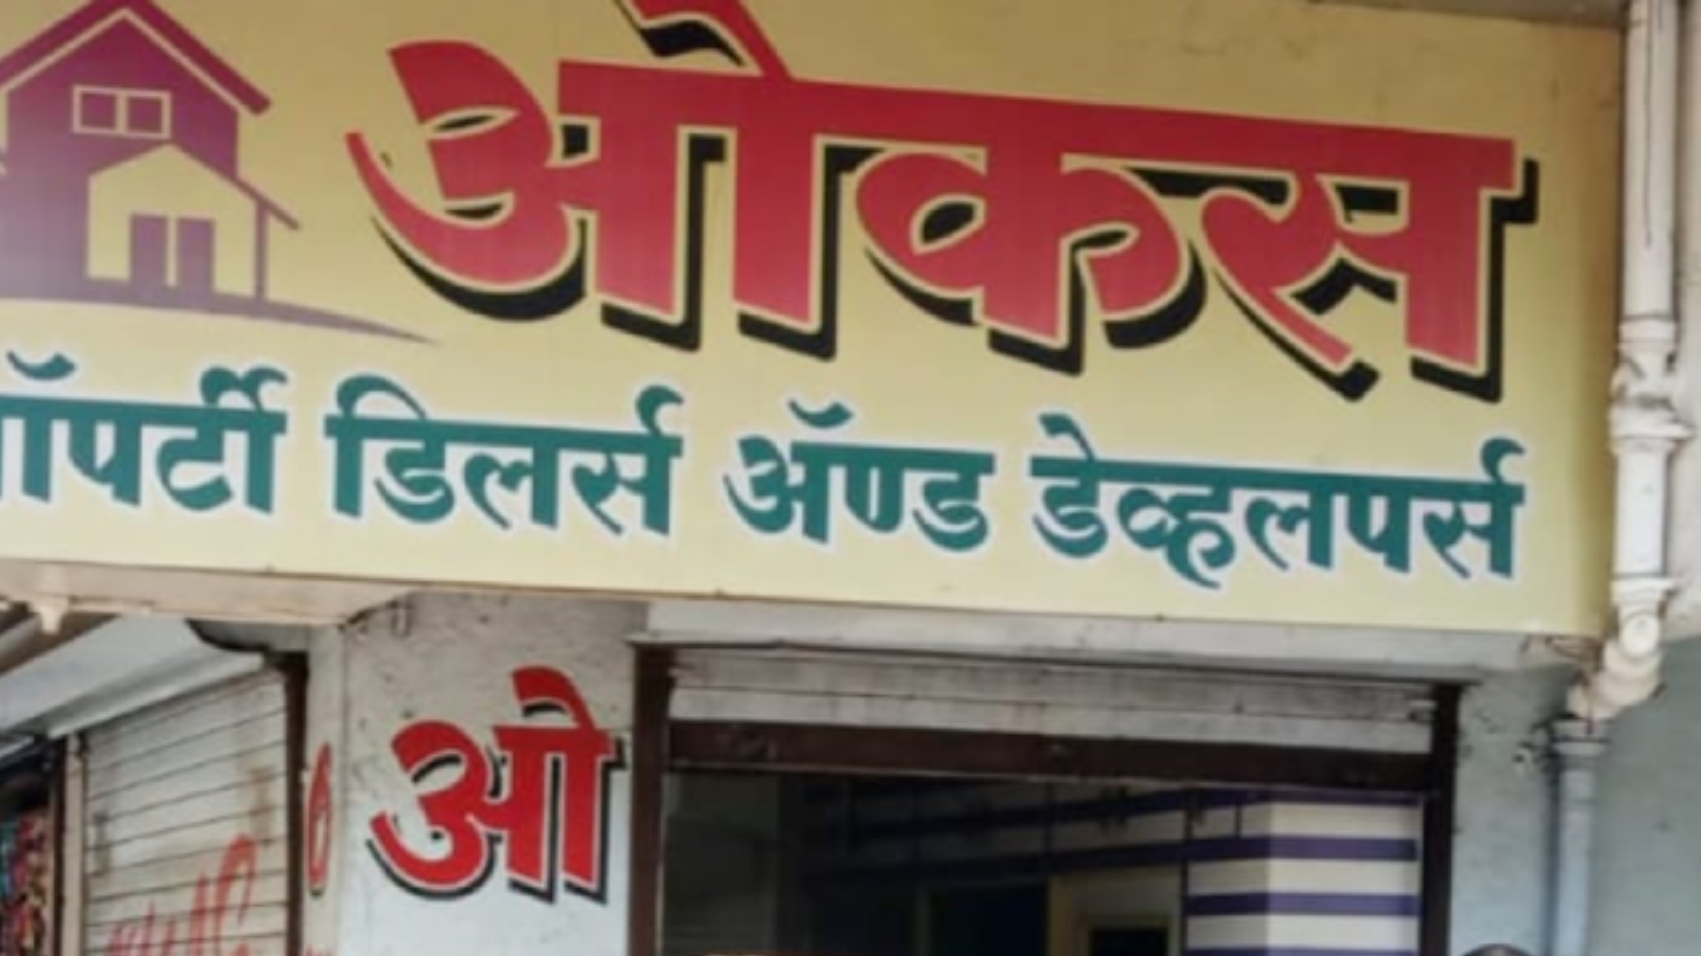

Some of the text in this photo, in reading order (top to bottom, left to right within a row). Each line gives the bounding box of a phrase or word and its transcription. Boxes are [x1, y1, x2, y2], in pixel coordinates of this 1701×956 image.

[345, 0, 1537, 402] ओकस
[325, 374, 684, 537] डिलर्स
[1029, 412, 1525, 590] डेव्हलपर्स
